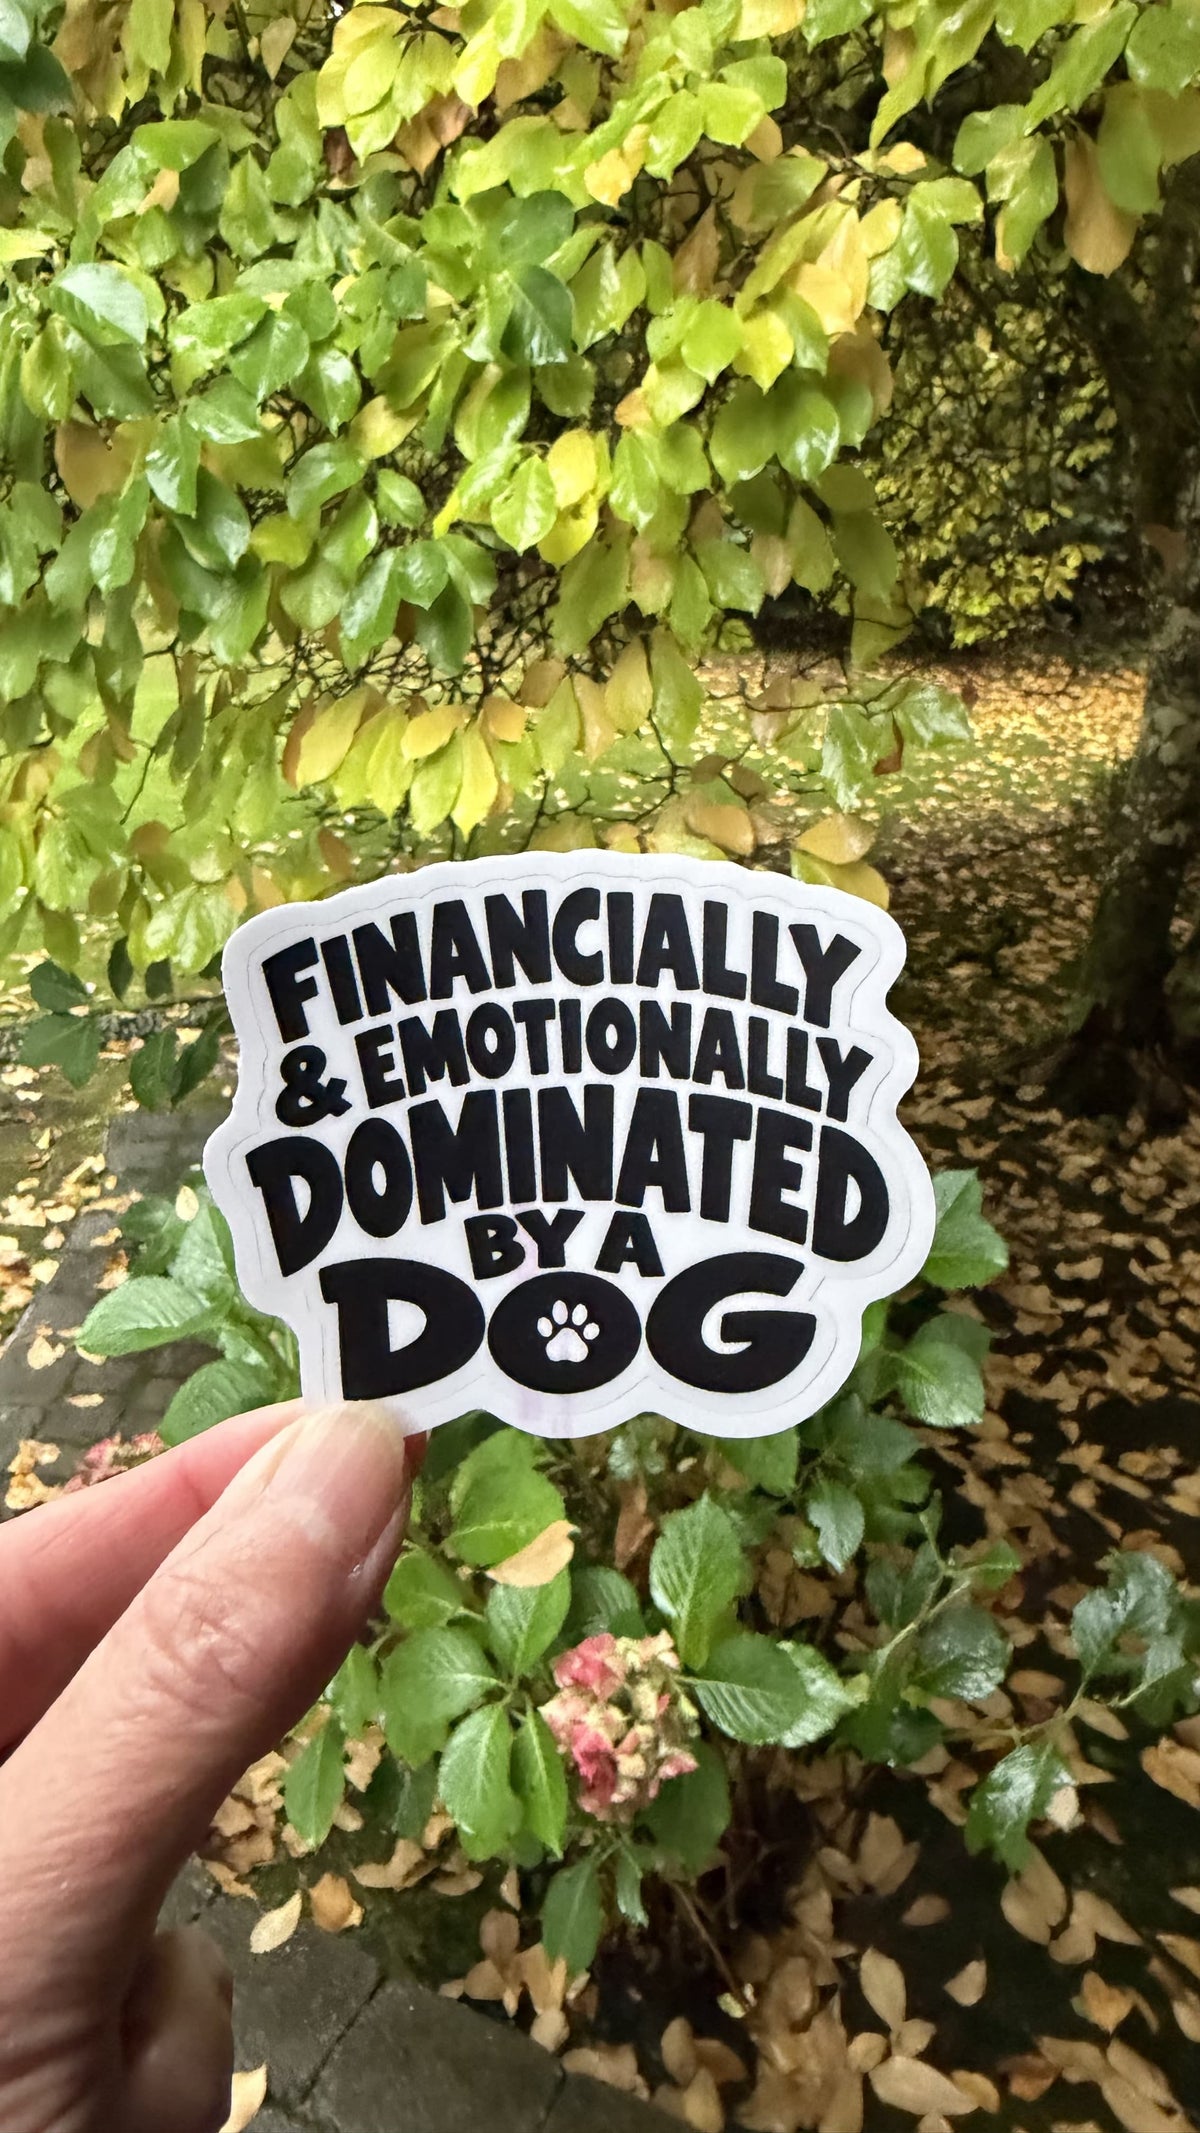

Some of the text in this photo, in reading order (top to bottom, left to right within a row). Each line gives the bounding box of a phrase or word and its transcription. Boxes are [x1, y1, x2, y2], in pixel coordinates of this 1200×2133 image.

[261, 887, 862, 1044] FINANCIALLY
[275, 998, 873, 1127] & EMOTIONALLY
[245, 1084, 889, 1278] DOMINATED
[464, 1209, 665, 1280] BY A
[319, 1252, 817, 1401] DOG
